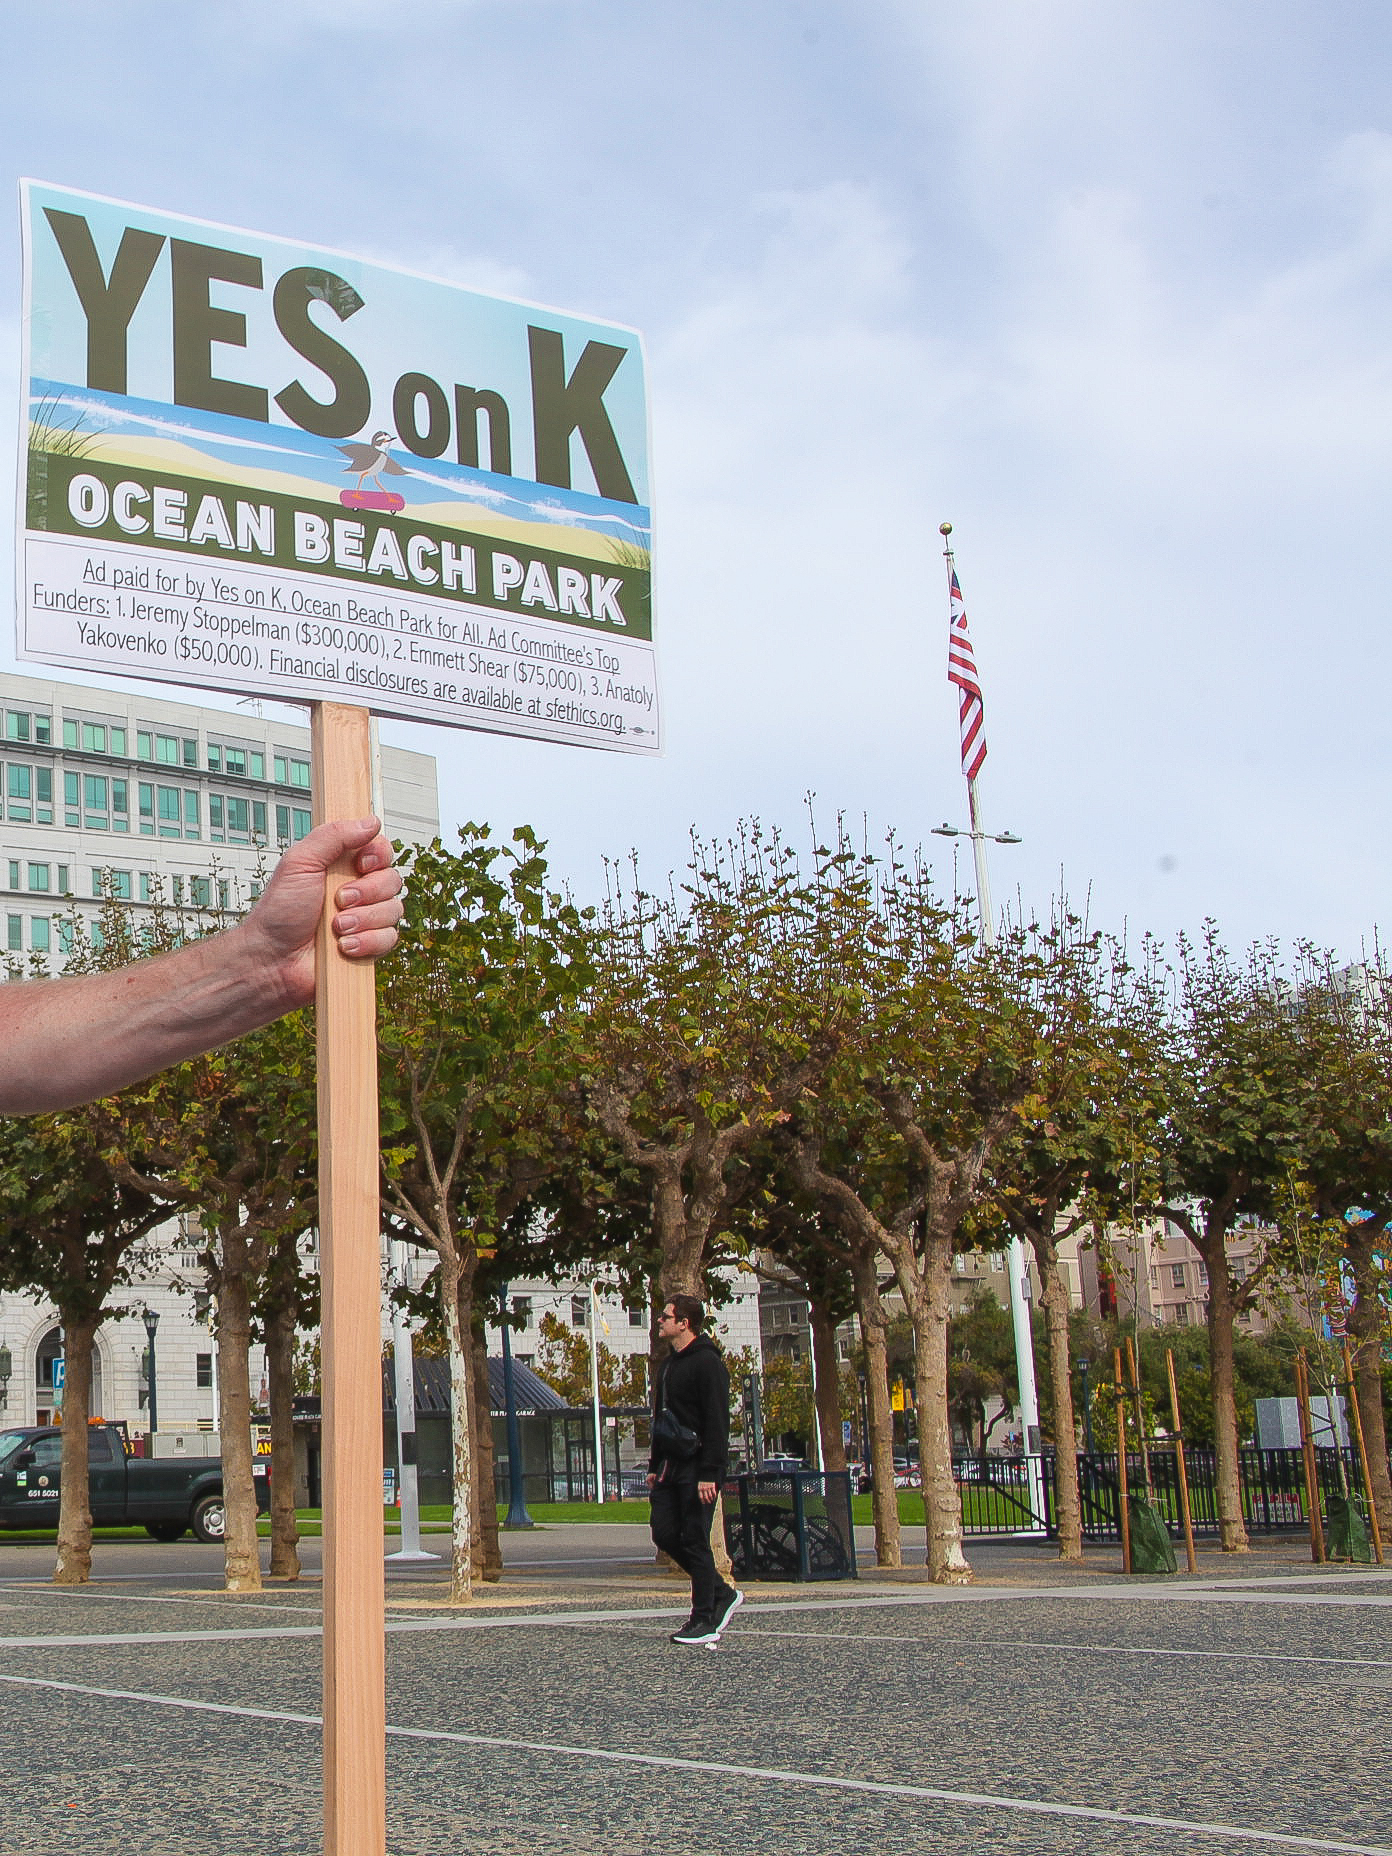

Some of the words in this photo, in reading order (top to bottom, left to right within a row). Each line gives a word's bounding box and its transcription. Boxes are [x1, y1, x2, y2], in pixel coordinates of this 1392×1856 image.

[42, 206, 371, 439] YES
[393, 372, 512, 476] on
[527, 324, 640, 505] K
[68, 473, 275, 556] OCEAN
[294, 511, 477, 595] BEACH
[492, 551, 627, 626] PARK
[33, 583, 110, 614] Funders:
[116, 595, 126, 617] 1.
[129, 597, 189, 633] Jeremy
[193, 606, 290, 642] Stoppelman
[295, 623, 390, 661] ($300,000),
[393, 638, 407, 661] 2.
[410, 641, 466, 672] Emmett
[468, 651, 510, 678] Shear
[513, 661, 587, 697] ($75,000),
[590, 675, 603, 697] 3.
[605, 678, 654, 711] Anatoly
[77, 620, 167, 655] Yakovenko
[174, 634, 263, 669] ($50,000).
[269, 648, 340, 679] Financial
[346, 661, 429, 695] disclosures
[433, 680, 457, 701] are
[462, 684, 523, 713] available
[527, 694, 542, 715] at
[546, 697, 627, 732] sfethics.org.
[83, 559, 106, 582] Ad
[113, 565, 149, 589] paid
[156, 569, 179, 592] for
[185, 573, 205, 602] by
[211, 577, 239, 602] Yes
[244, 588, 265, 606] on
[291, 590, 341, 618] Ocean
[348, 599, 394, 628] Beach
[400, 609, 432, 635] Park
[437, 617, 458, 639] for
[488, 626, 506, 649] Ad
[511, 631, 594, 666] Committee's
[594, 648, 620, 675] Top
